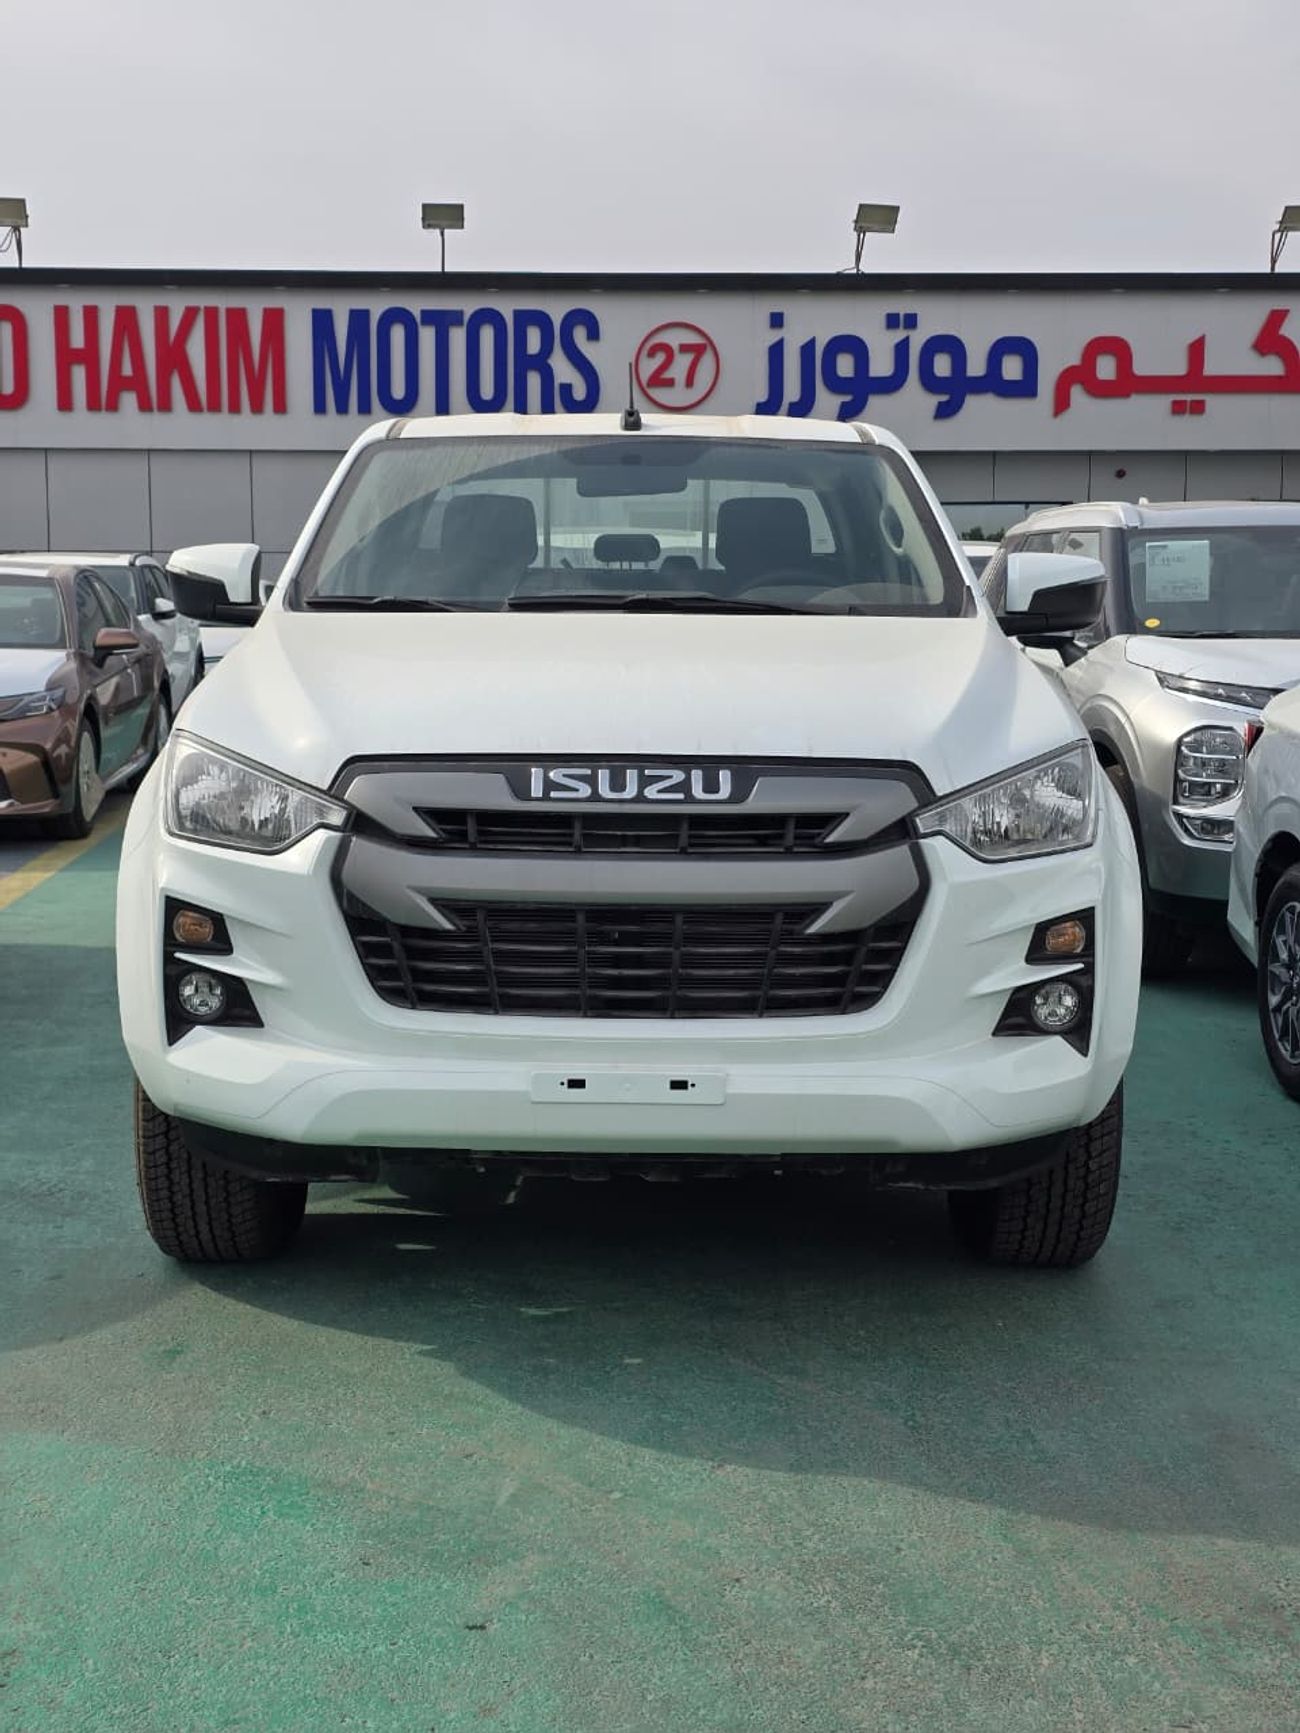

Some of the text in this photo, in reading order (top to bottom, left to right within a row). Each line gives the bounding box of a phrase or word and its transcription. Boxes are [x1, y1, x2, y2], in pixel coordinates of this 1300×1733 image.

[53, 304, 288, 413] HAKIM
[310, 306, 601, 415] MOTORS
[646, 342, 707, 387] 27
[755, 312, 1039, 422] موتورز
[530, 767, 732, 800] ISUZU
